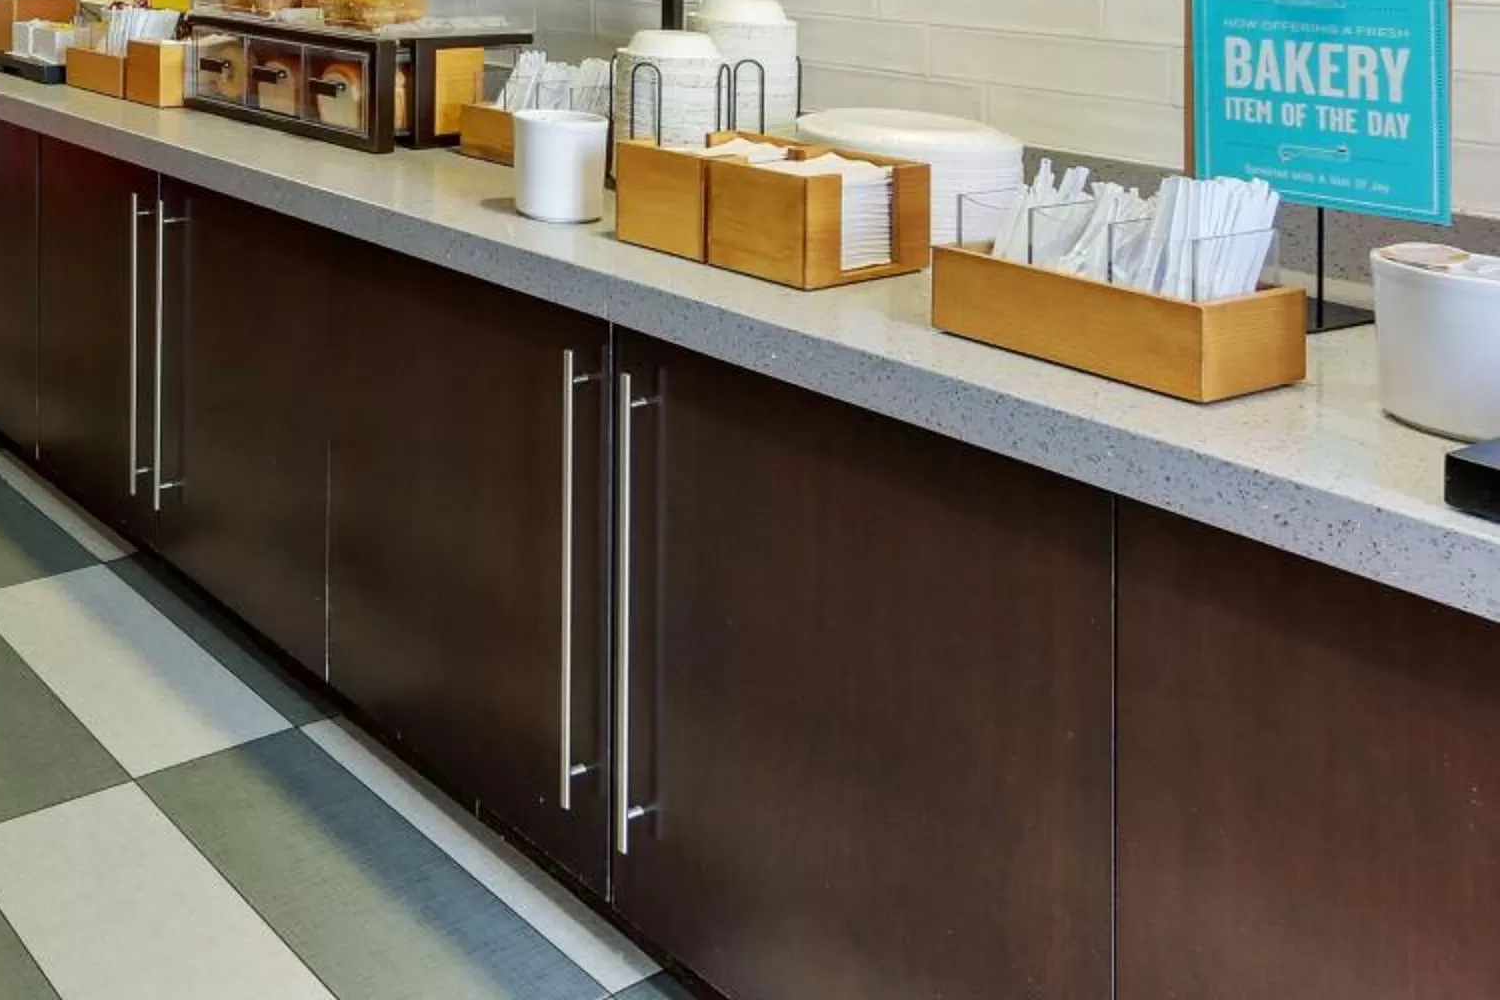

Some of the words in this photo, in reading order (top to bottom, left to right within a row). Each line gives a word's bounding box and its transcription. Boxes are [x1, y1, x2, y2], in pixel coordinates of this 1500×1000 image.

[1223, 16, 1258, 30] NOW
[1225, 36, 1410, 103] BAKERY
[1225, 96, 1273, 123] ITEM
[1282, 101, 1307, 128] OF
[1316, 105, 1357, 134] THE
[1369, 112, 1410, 139] DAY
